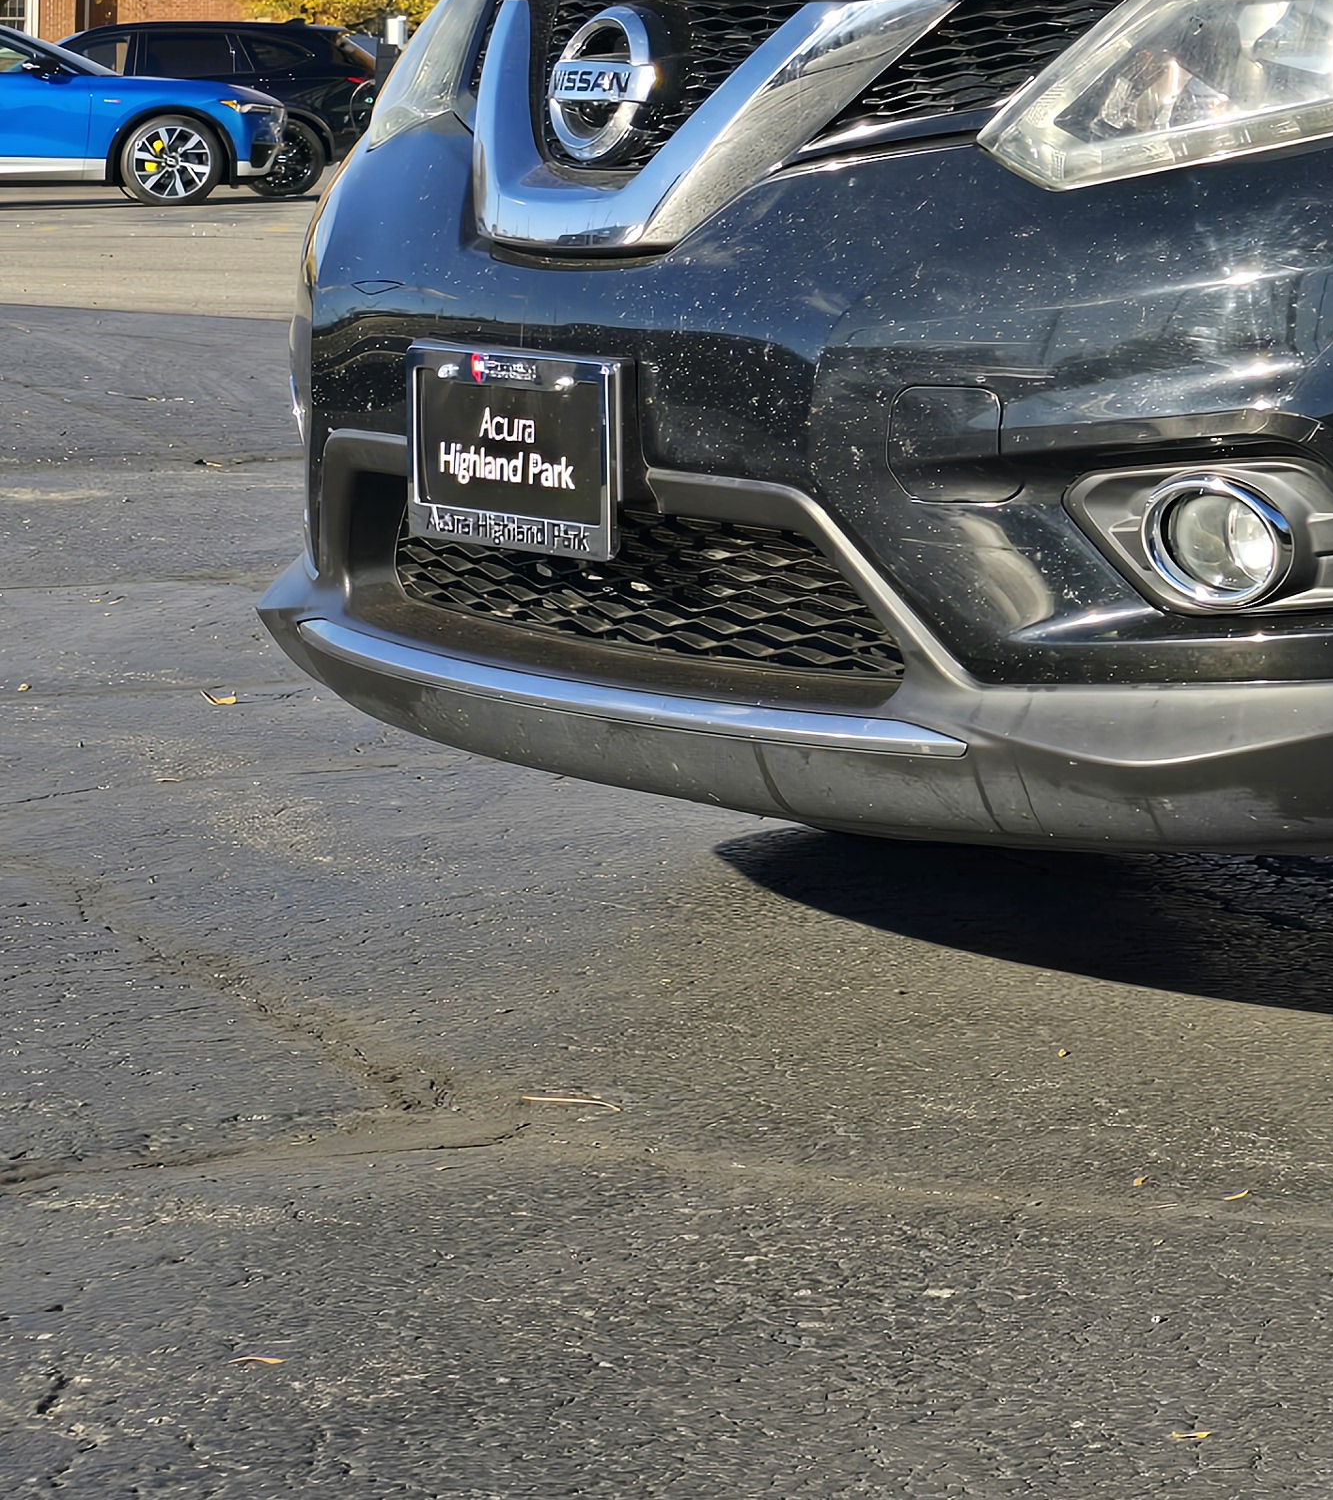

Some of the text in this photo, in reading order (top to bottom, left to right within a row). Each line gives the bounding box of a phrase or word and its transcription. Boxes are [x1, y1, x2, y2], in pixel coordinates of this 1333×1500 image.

[553, 70, 631, 93] NISSAN
[479, 406, 535, 444] Acura
[440, 441, 576, 490] Highland Park
